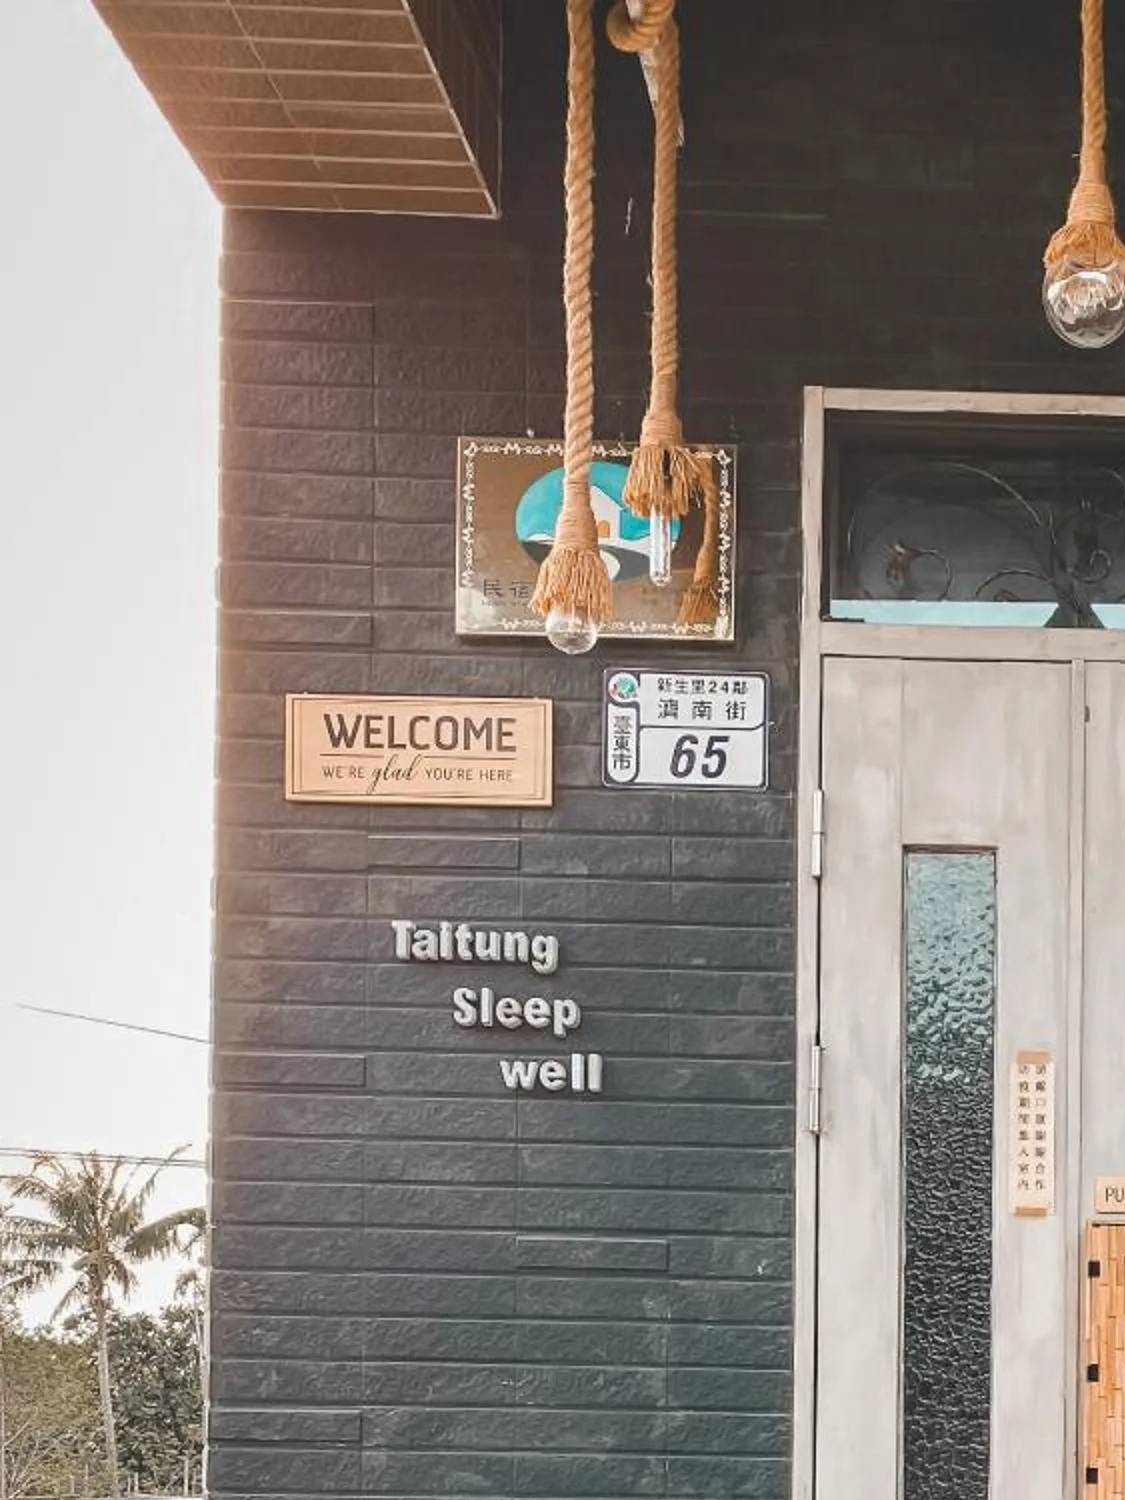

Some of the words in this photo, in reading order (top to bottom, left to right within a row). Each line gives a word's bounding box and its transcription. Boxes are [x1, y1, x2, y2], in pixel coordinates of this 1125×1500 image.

[657, 677, 748, 695] 新生里24鄰
[657, 698, 747, 721] 濟南街
[323, 713, 517, 752] WELCOME
[612, 715, 634, 771] 臺東市
[322, 765, 365, 779] WE'RE
[366, 753, 422, 795] glad
[425, 767, 473, 782] YOU'RE
[479, 769, 513, 782] HERE
[669, 733, 731, 779] 65
[391, 920, 559, 975] Taitung
[452, 986, 582, 1038] Sleep
[500, 1053, 602, 1092] well
